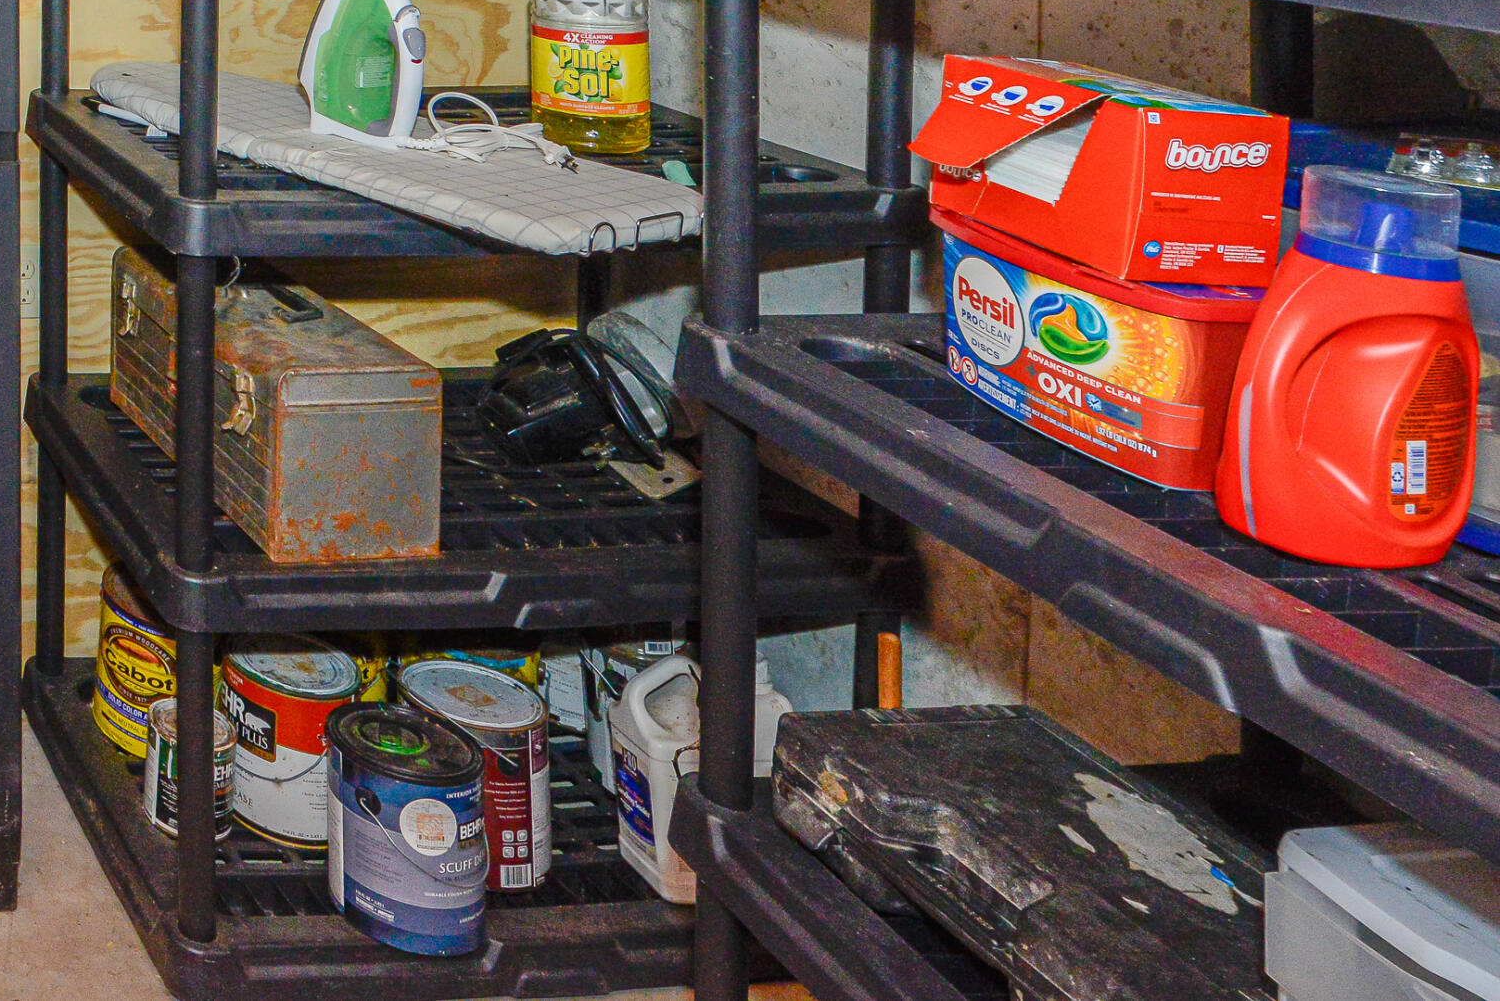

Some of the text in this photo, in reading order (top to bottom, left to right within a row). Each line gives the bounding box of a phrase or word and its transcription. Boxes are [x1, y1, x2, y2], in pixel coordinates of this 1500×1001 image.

[563, 32, 580, 43] 4X
[563, 68, 609, 98] Sol
[1165, 139, 1269, 173] bounce
[958, 275, 1015, 330] Persil
[971, 337, 1000, 360] DISCS
[1026, 351, 1142, 404] ADVANCED DEEP CLEAN
[1037, 372, 1082, 408] OXI
[105, 647, 174, 692] Cabot
[122, 702, 143, 718] COLOR
[242, 724, 268, 750] PLUS
[237, 791, 253, 807] ASE
[439, 859, 474, 874] SCUFF
